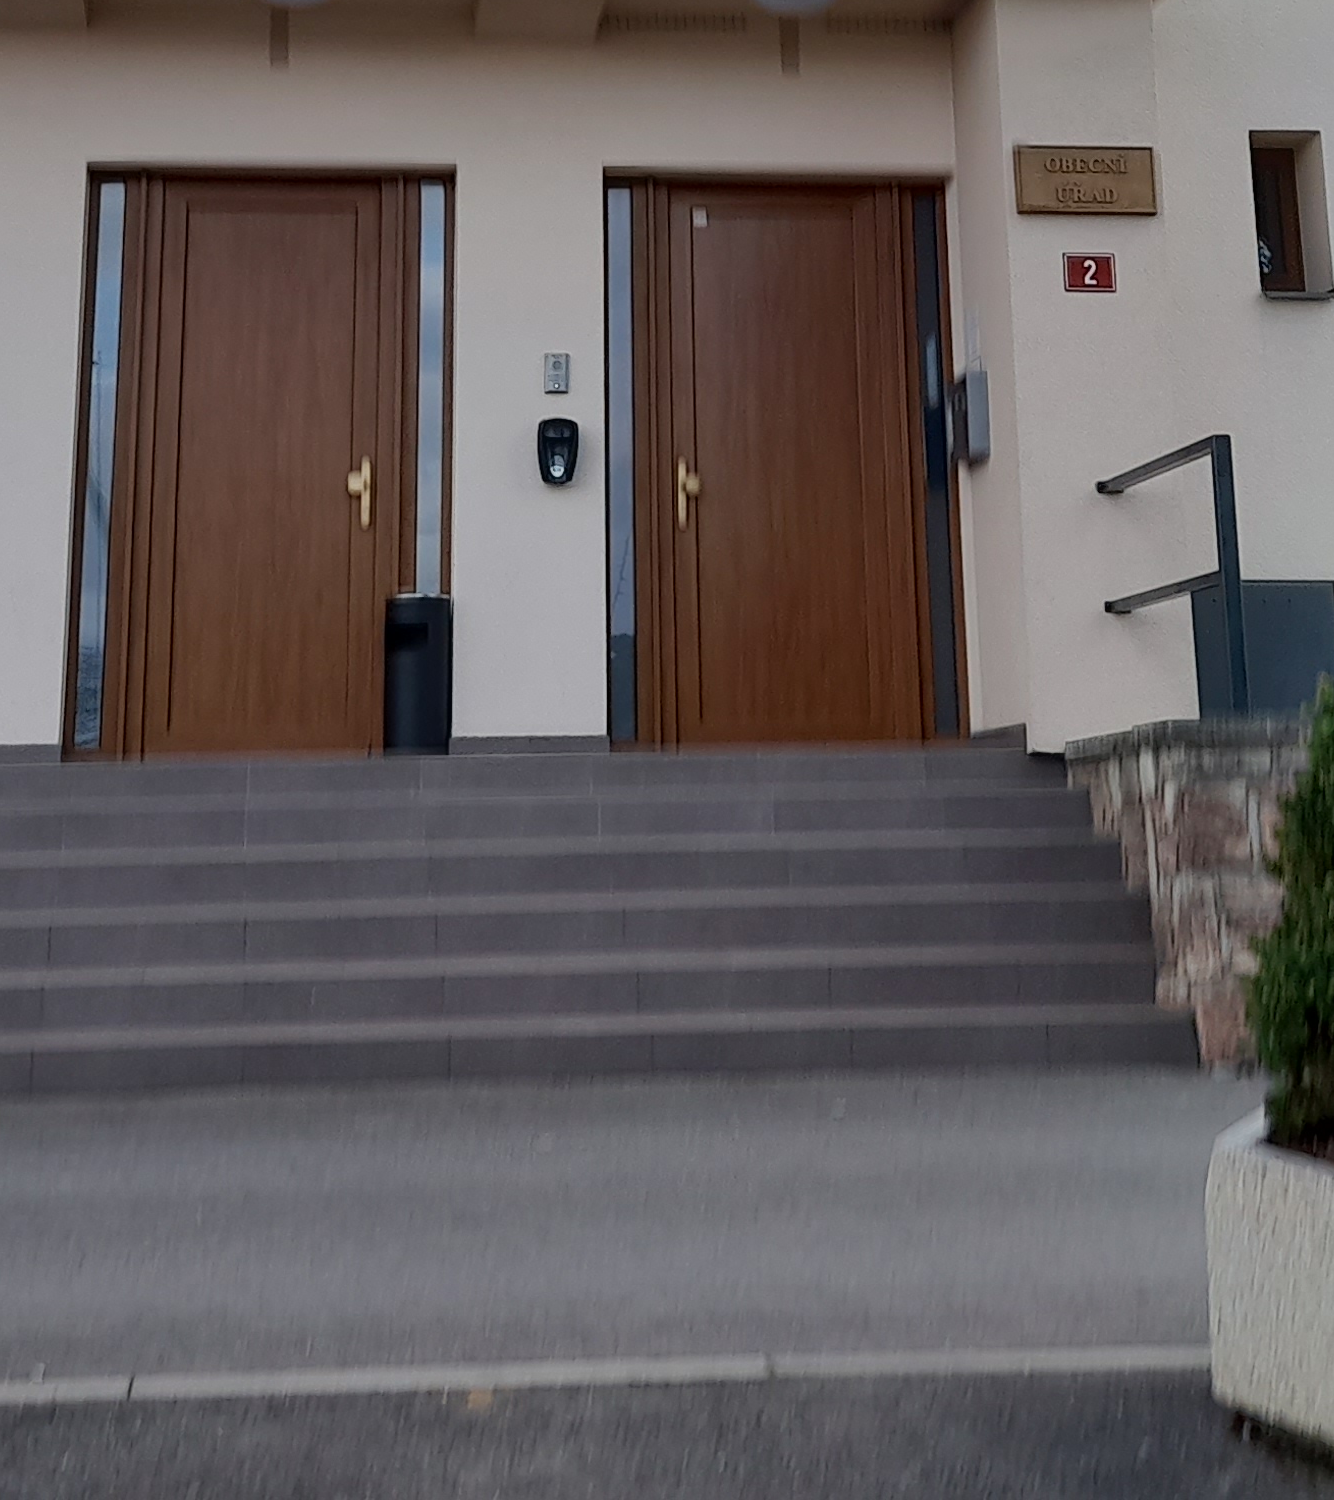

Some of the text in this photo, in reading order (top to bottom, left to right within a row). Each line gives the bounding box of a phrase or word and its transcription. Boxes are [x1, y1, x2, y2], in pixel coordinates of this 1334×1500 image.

[1044, 153, 1128, 174] OBECNÍ
[1055, 181, 1119, 204] ÚŘAD
[1083, 259, 1097, 285] 2
